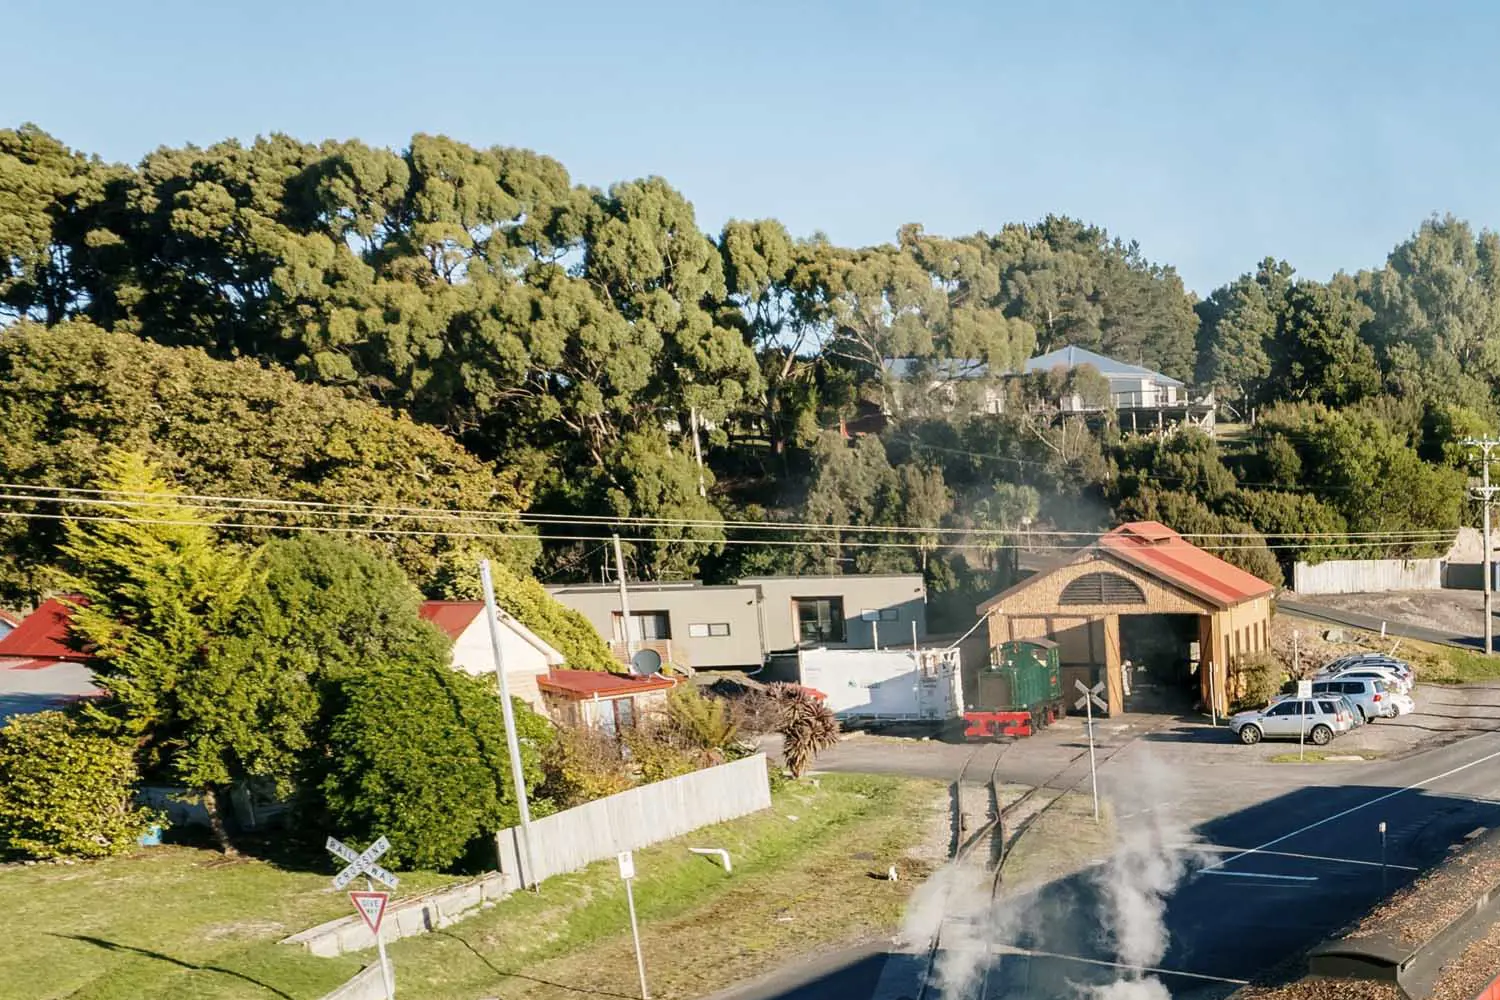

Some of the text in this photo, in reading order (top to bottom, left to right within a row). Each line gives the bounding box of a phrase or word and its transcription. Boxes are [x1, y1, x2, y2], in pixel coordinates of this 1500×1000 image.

[330, 840, 395, 885] RAIL WAY
[337, 841, 385, 886] CROSSING
